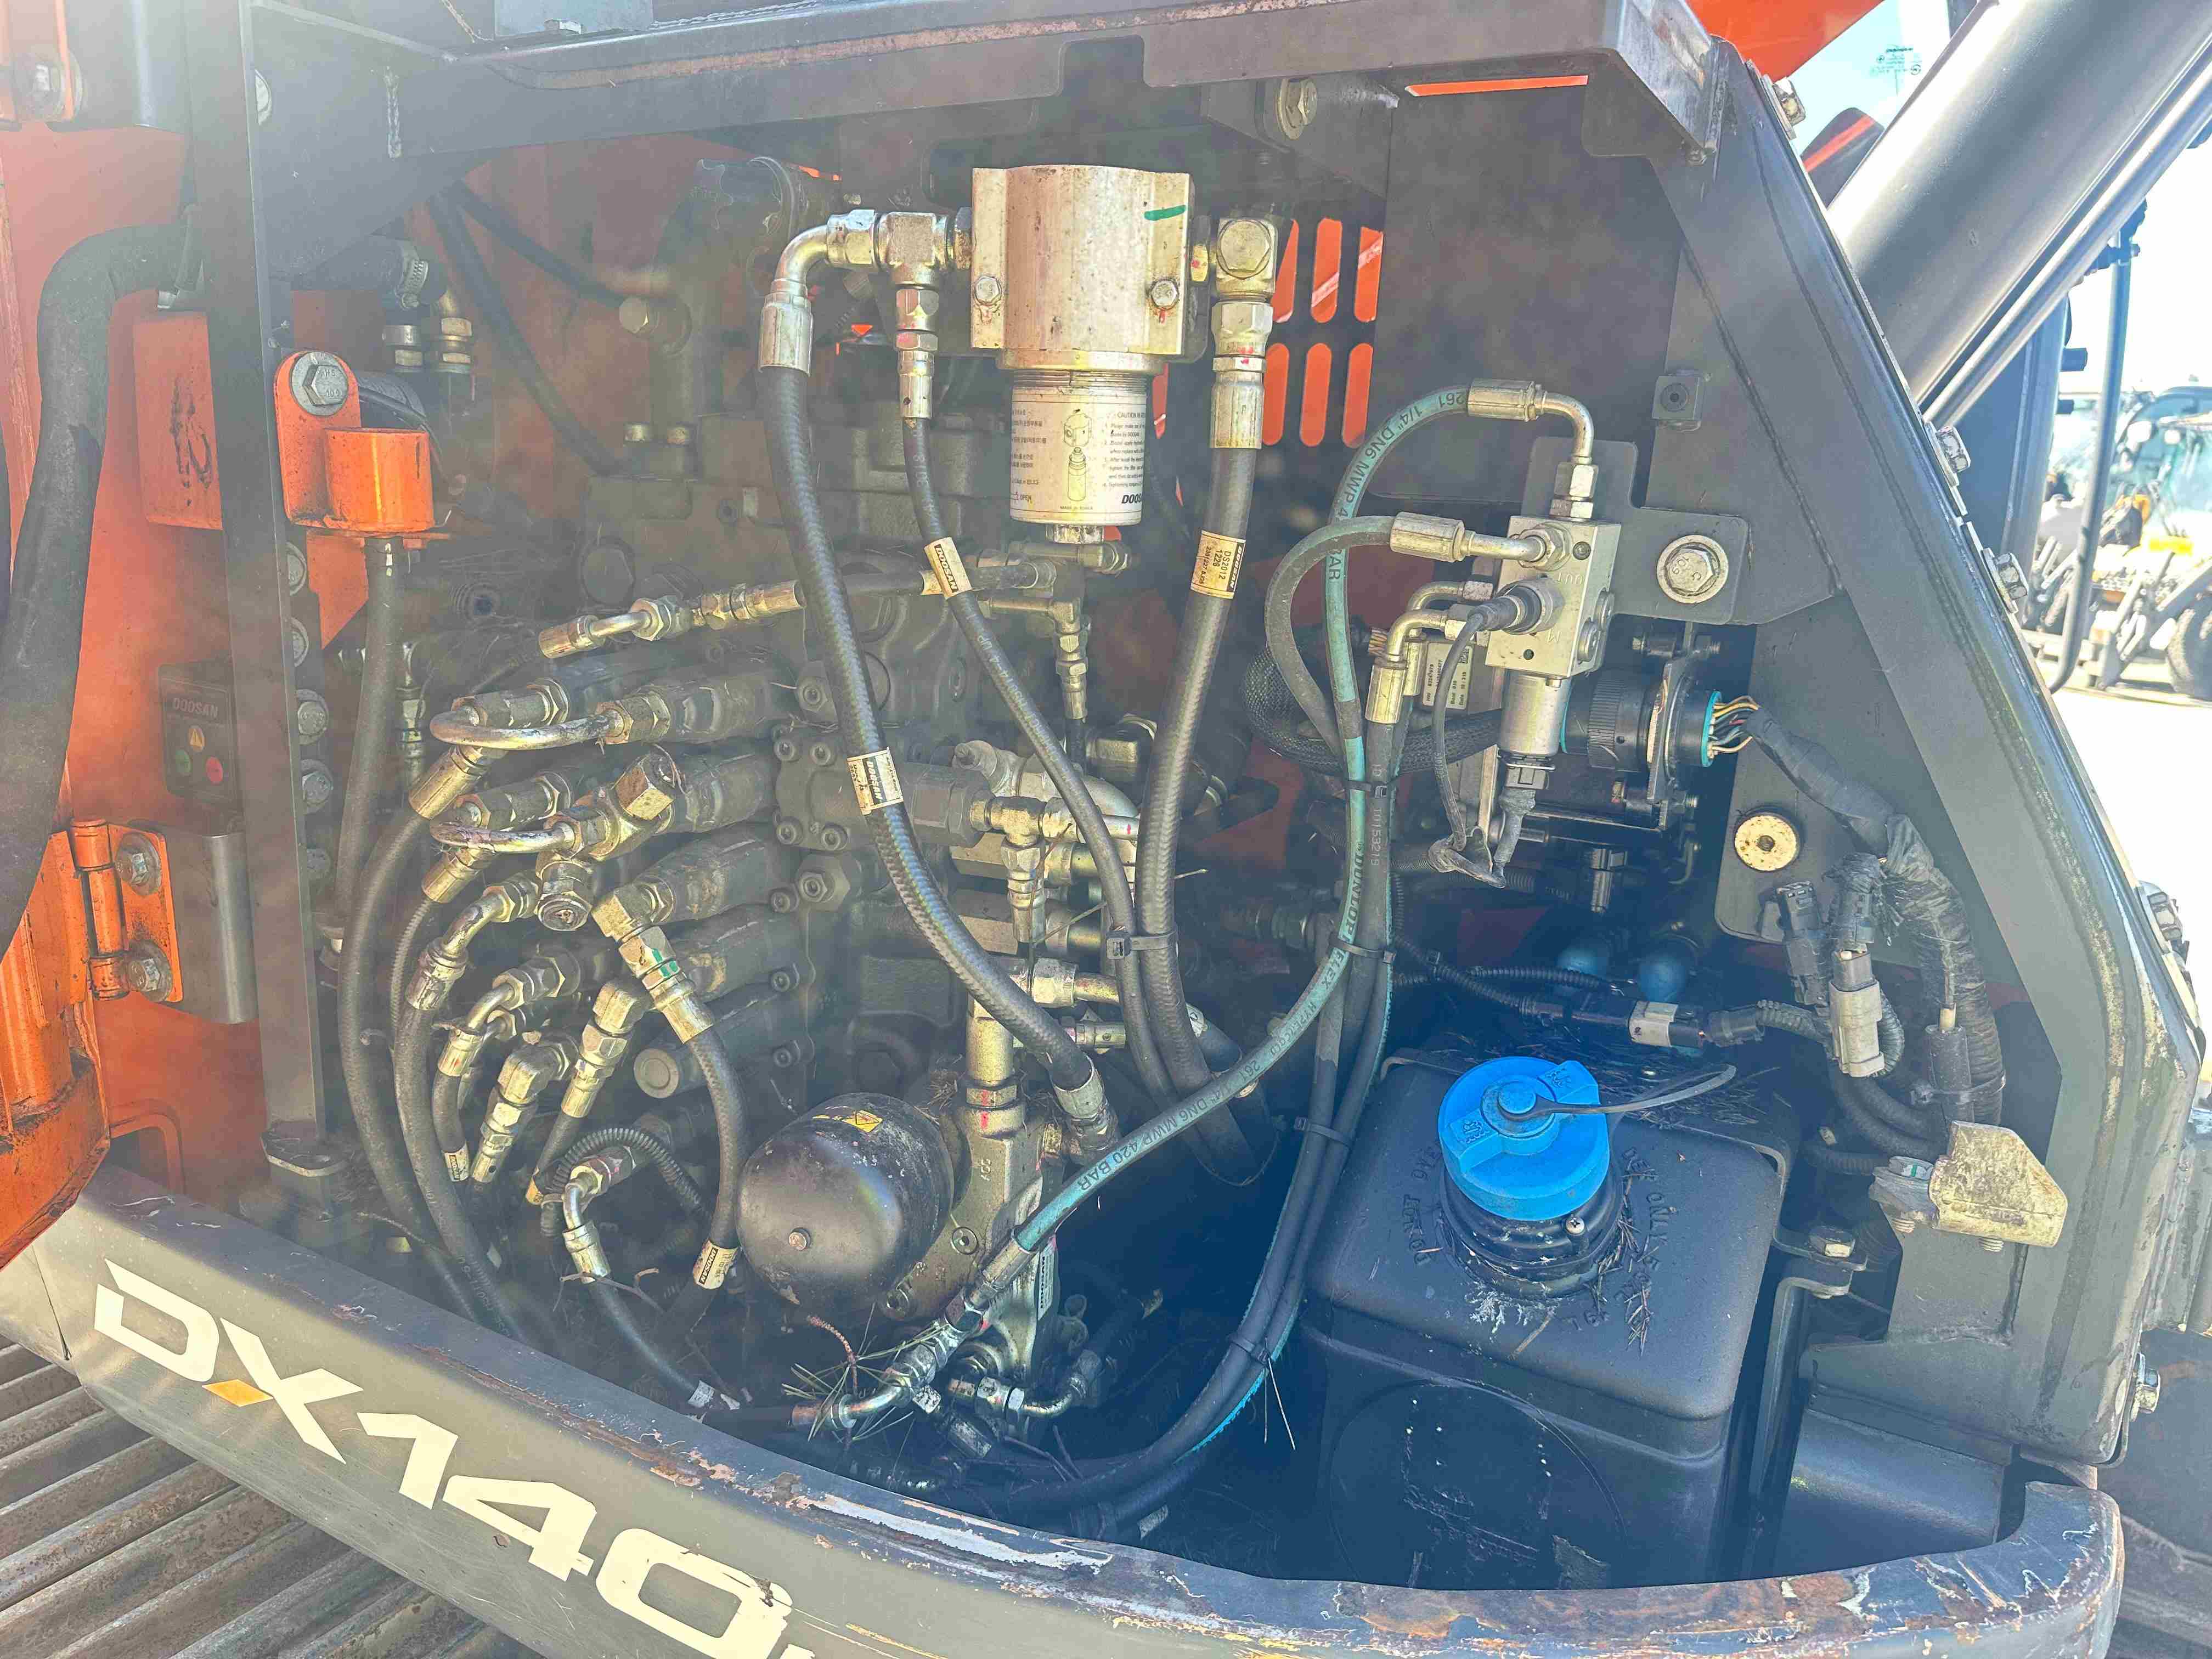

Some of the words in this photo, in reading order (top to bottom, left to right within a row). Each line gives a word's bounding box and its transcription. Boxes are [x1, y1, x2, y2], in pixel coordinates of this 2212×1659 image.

[1364, 426, 1395, 459] DN6
[1345, 460, 1370, 504] MWP
[935, 547, 958, 589] DOOSAN
[1219, 550, 1232, 580] DS2012
[1230, 545, 1243, 589] DOOSAN
[173, 697, 219, 718] DOOSAN
[866, 761, 883, 799] DOOSAN
[1343, 854, 1365, 937] DUNLOP
[1180, 1099, 1208, 1120] DN6
[1143, 1114, 1178, 1146] MWP
[1113, 1139, 1141, 1166] 420
[1078, 1160, 1113, 1192] BAR
[700, 1248, 717, 1283] DOOSAN
